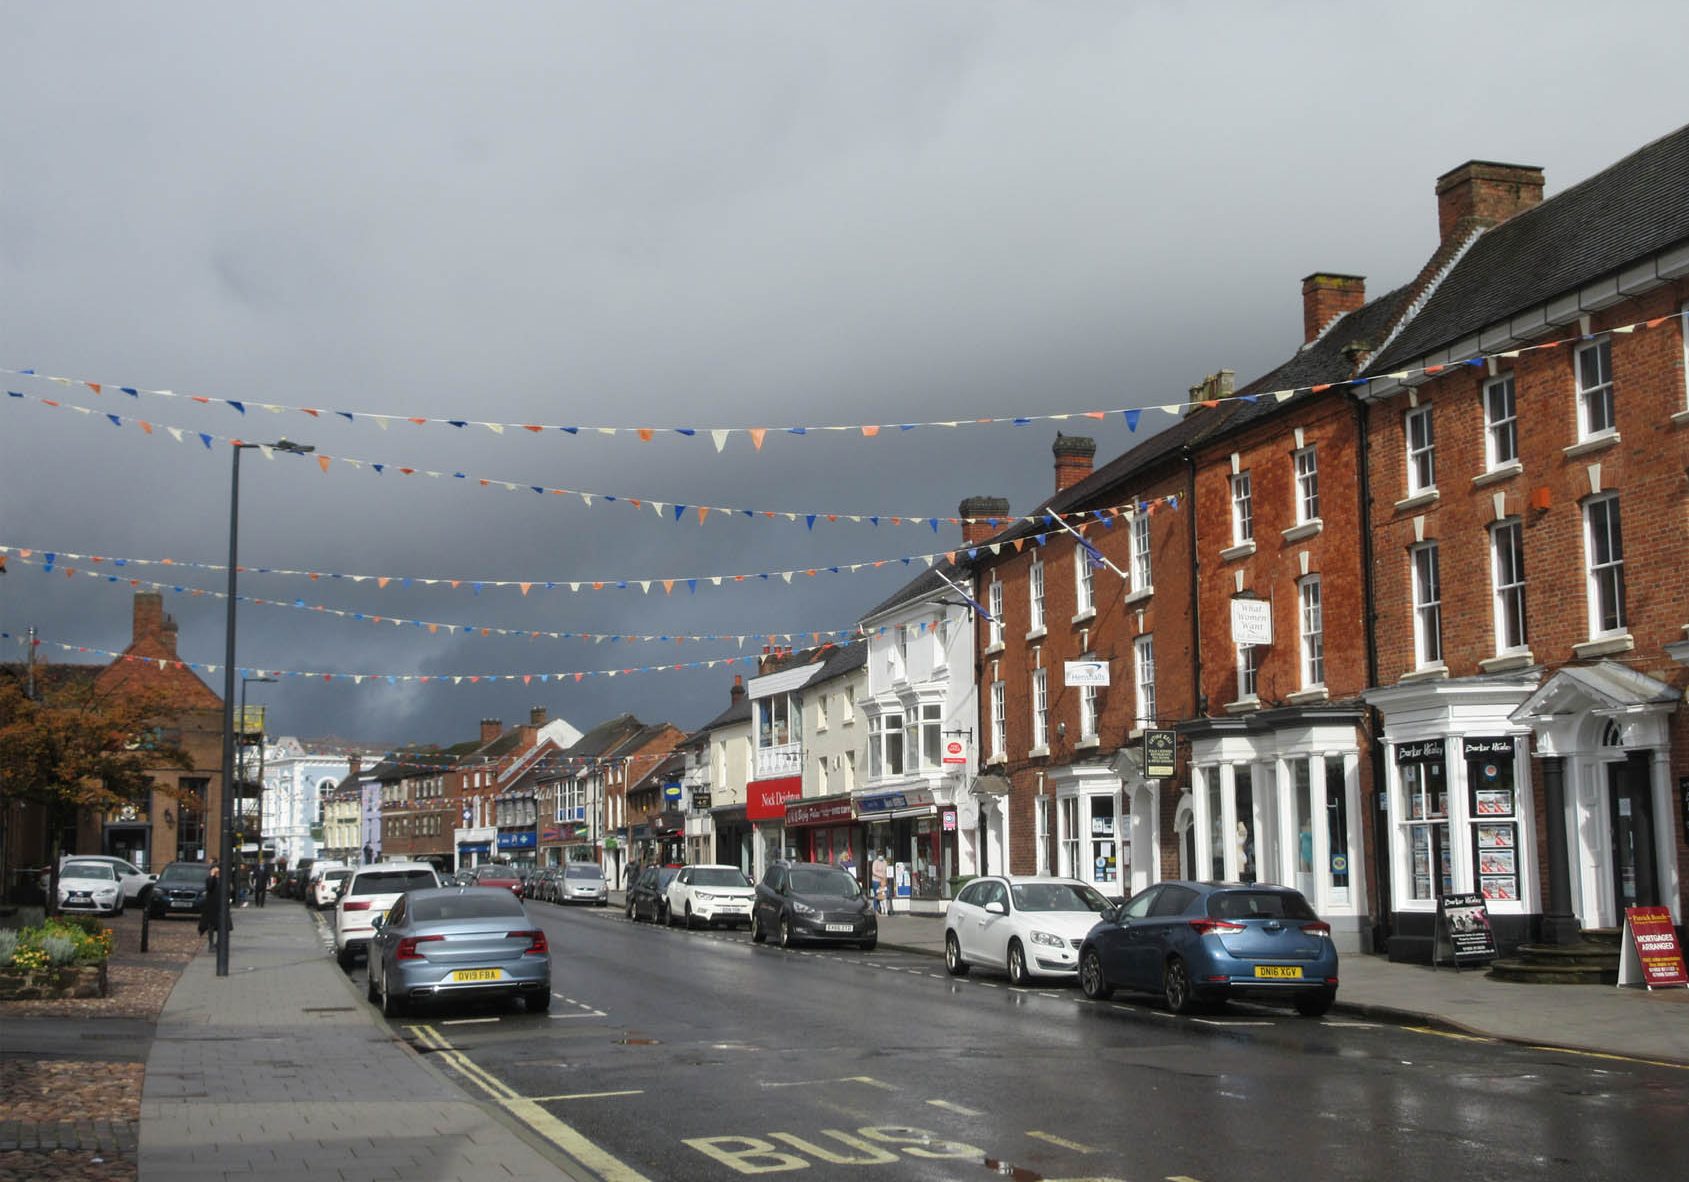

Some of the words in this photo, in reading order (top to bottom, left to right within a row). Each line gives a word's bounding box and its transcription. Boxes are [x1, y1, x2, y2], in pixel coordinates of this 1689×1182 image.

[1238, 613, 1267, 621] Women
[1241, 621, 1263, 630] Want
[761, 792, 776, 807] Nock
[1637, 934, 1673, 942] MORTGAGES
[458, 971, 477, 981] DV19
[479, 970, 496, 980] FBA
[1260, 968, 1278, 976] DN16
[1281, 968, 1296, 976] XGV
[681, 1125, 986, 1174] BUS
